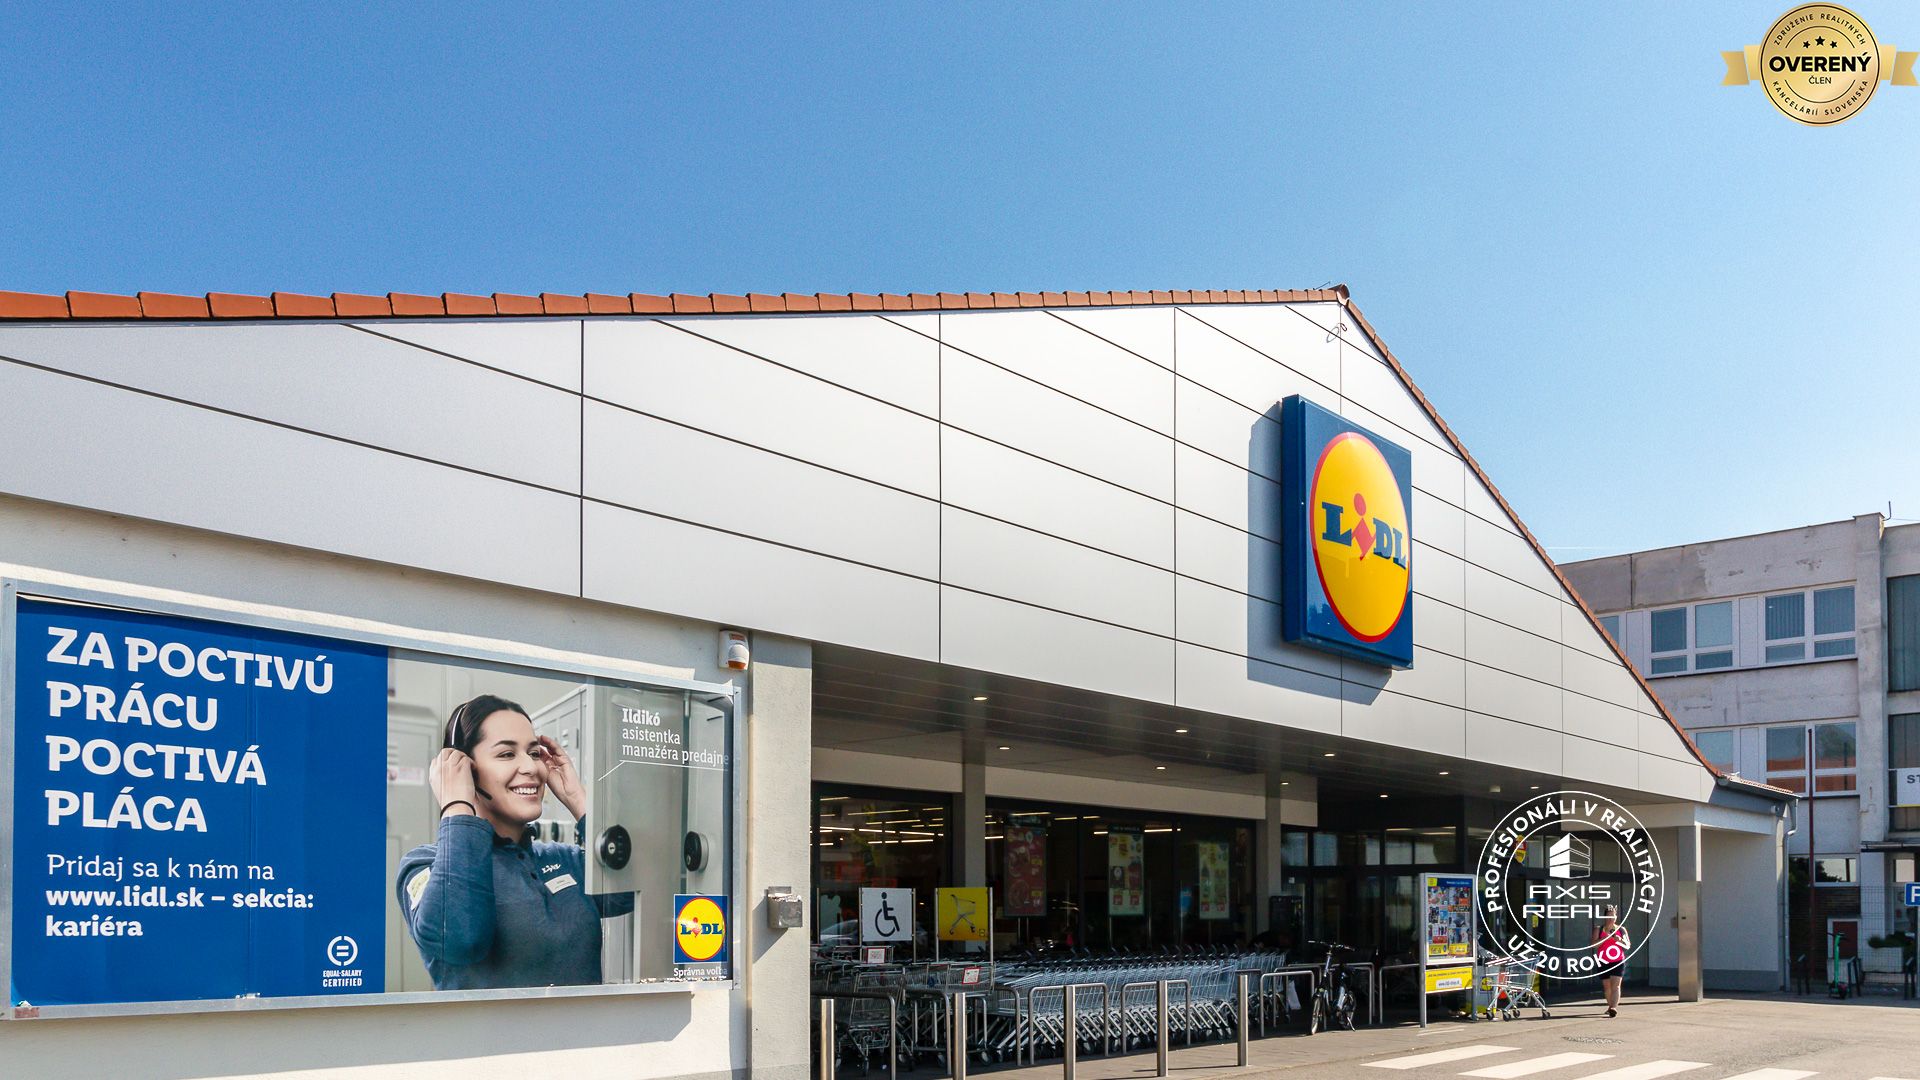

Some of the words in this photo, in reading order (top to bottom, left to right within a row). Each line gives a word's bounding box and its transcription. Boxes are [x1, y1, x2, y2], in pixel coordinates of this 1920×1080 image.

[46, 626, 115, 670] ZA
[124, 636, 334, 694] POCTIVÚ
[46, 681, 218, 731] PRÁCU
[622, 708, 661, 727] Ildikó
[622, 727, 681, 745] asistentka
[45, 735, 267, 786] POCTIVÁ
[622, 744, 679, 761] manažéra
[44, 786, 208, 833] PLÁCA
[47, 854, 124, 882] Pridaj
[132, 861, 159, 879] sa
[168, 857, 179, 879] k
[188, 859, 239, 880] nám
[247, 865, 275, 881] na
[46, 886, 205, 908] www.lidl.sk
[232, 888, 314, 909] sekcia:
[46, 915, 143, 937] kariéra
[322, 978, 363, 988] CERTIFIED
[673, 967, 706, 978] Správna
